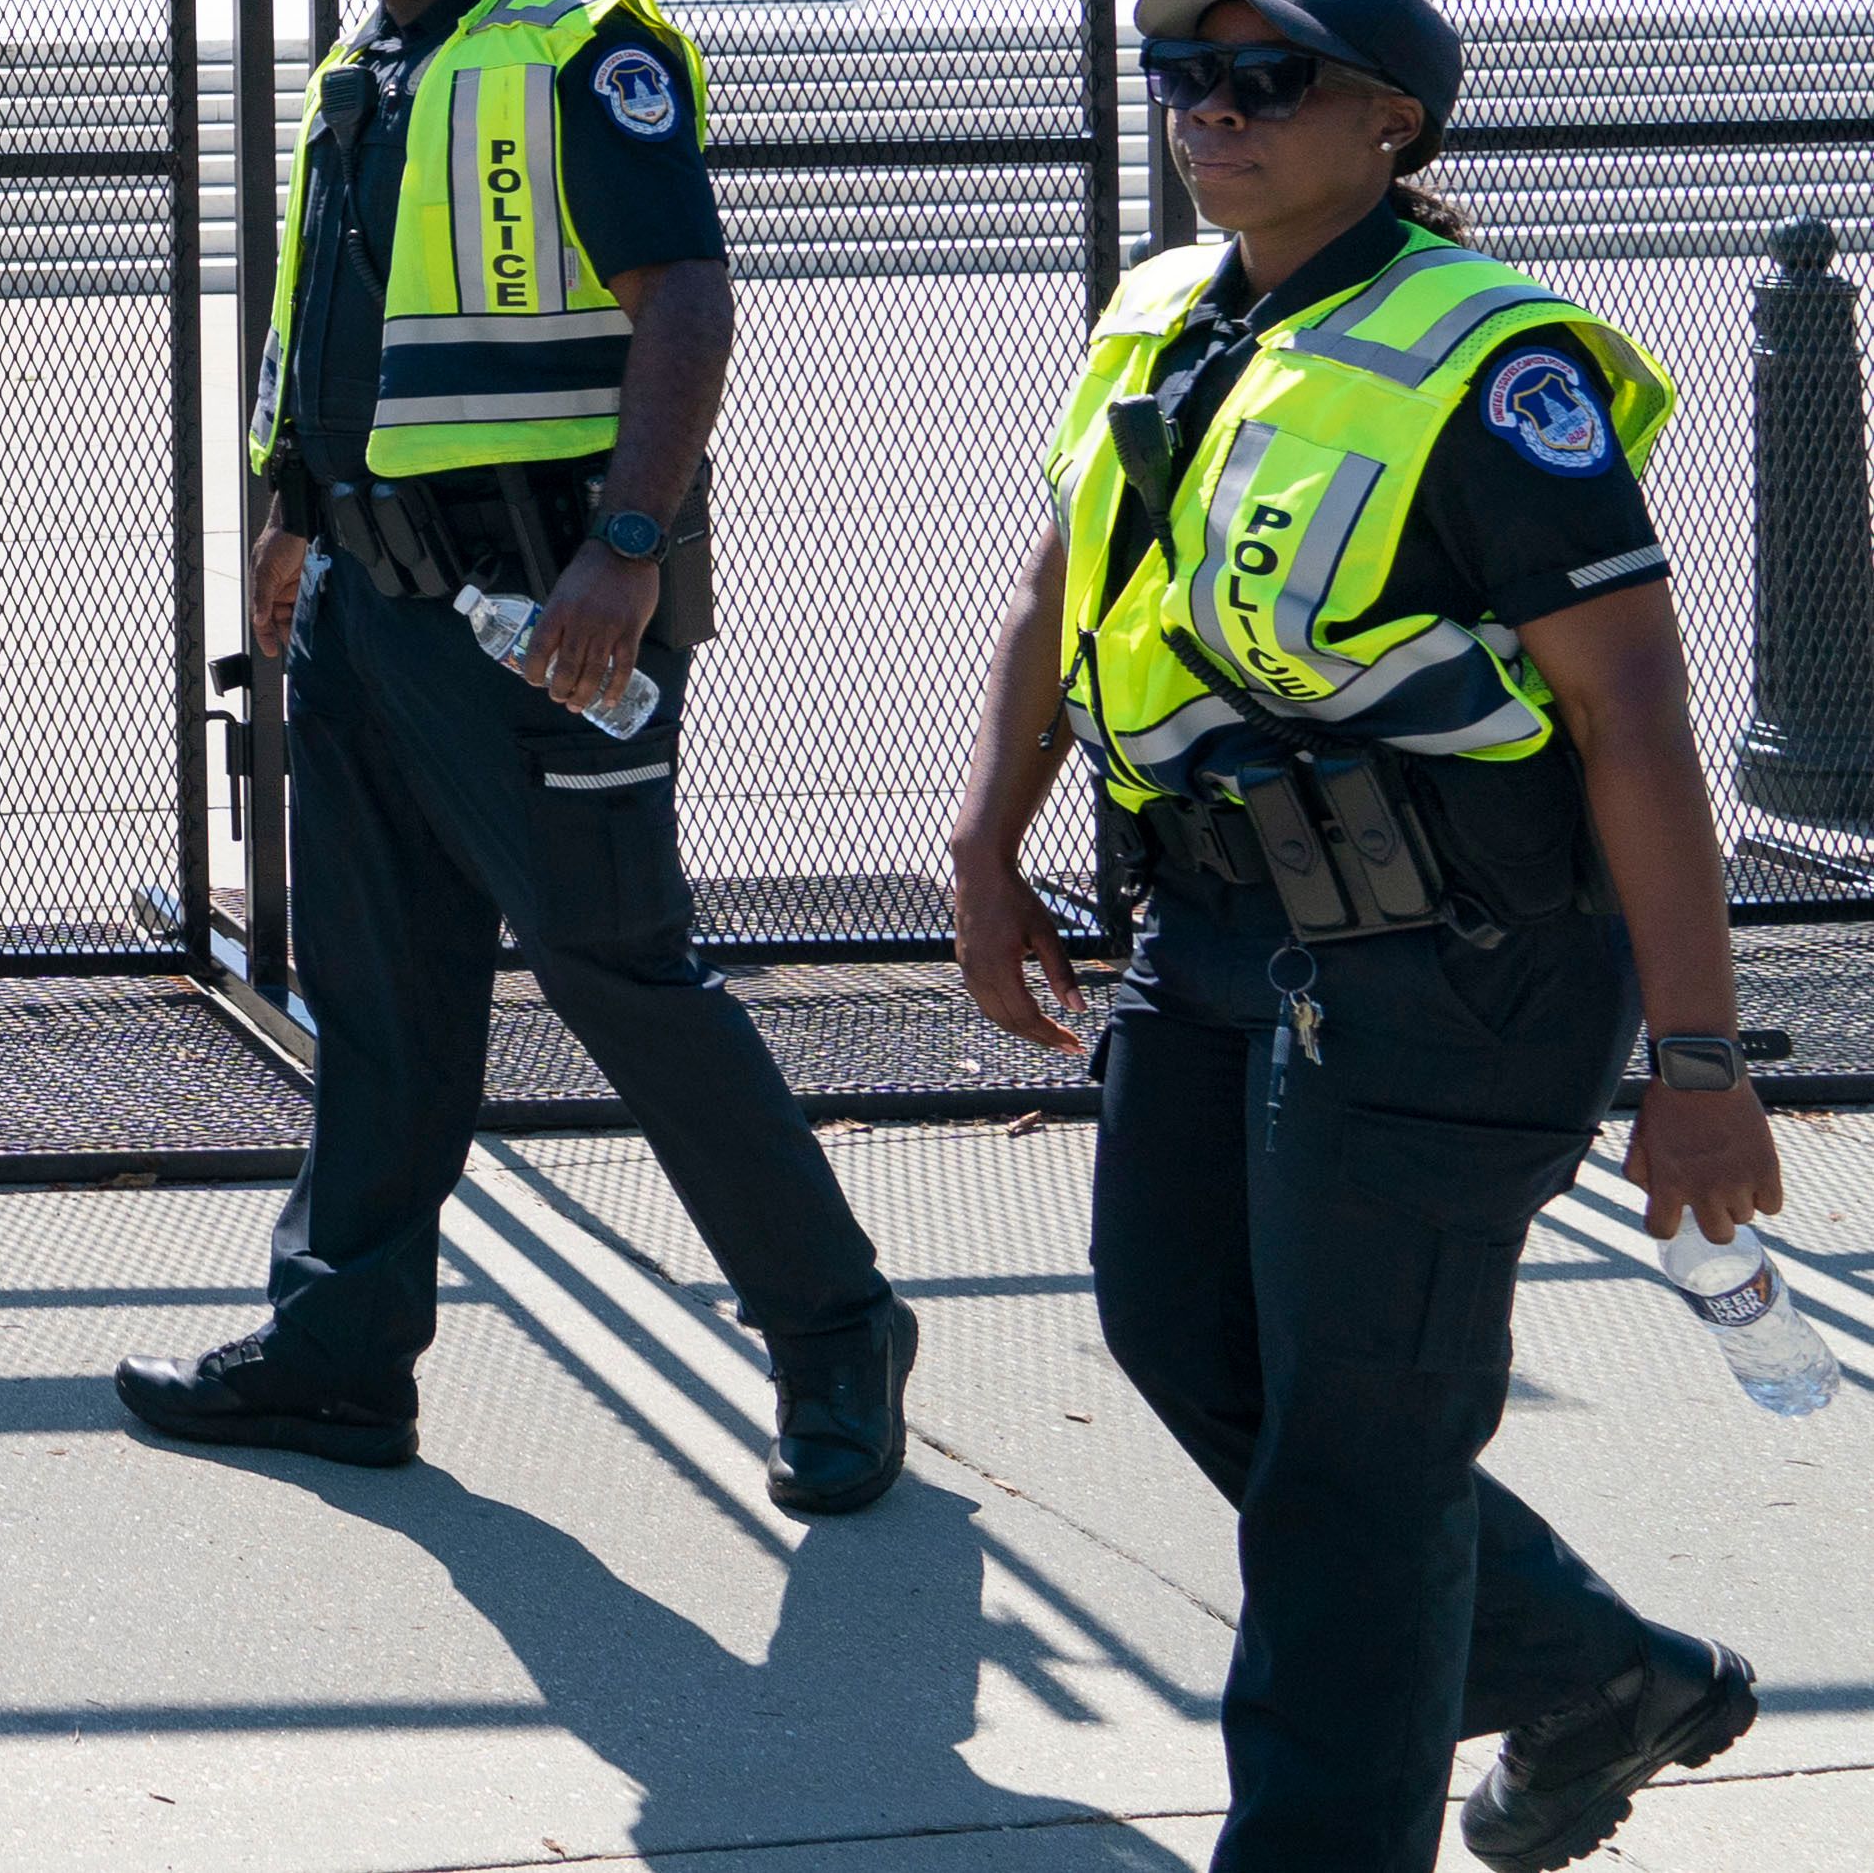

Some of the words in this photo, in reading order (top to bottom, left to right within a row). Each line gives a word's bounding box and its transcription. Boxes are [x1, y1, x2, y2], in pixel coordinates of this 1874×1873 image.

[487, 139, 527, 307] POLICE
[1229, 504, 1319, 698] POLICE
[1706, 1287, 1757, 1311] DEER
[1714, 1297, 1765, 1319] PARK
